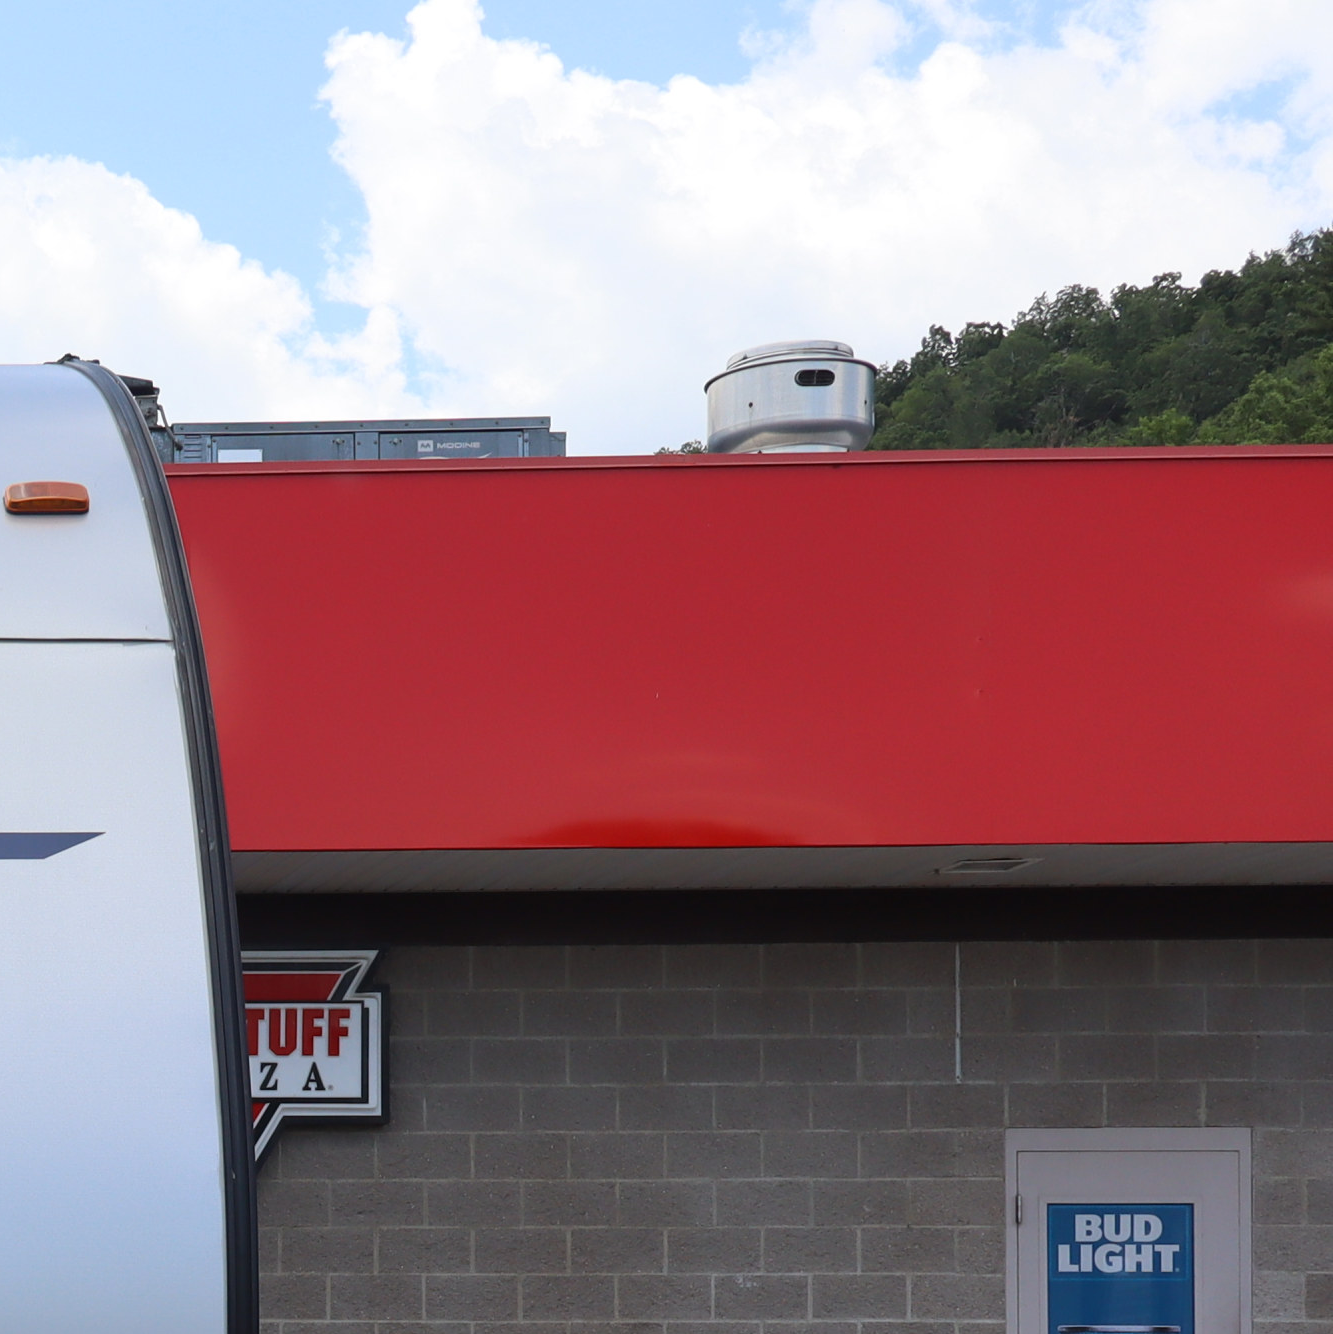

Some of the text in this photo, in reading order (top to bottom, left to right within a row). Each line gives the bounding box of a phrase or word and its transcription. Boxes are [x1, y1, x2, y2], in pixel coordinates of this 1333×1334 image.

[436, 441, 481, 449] MODINE
[1074, 1213, 1163, 1243] BUD
[1057, 1243, 1180, 1274] LIGHT
